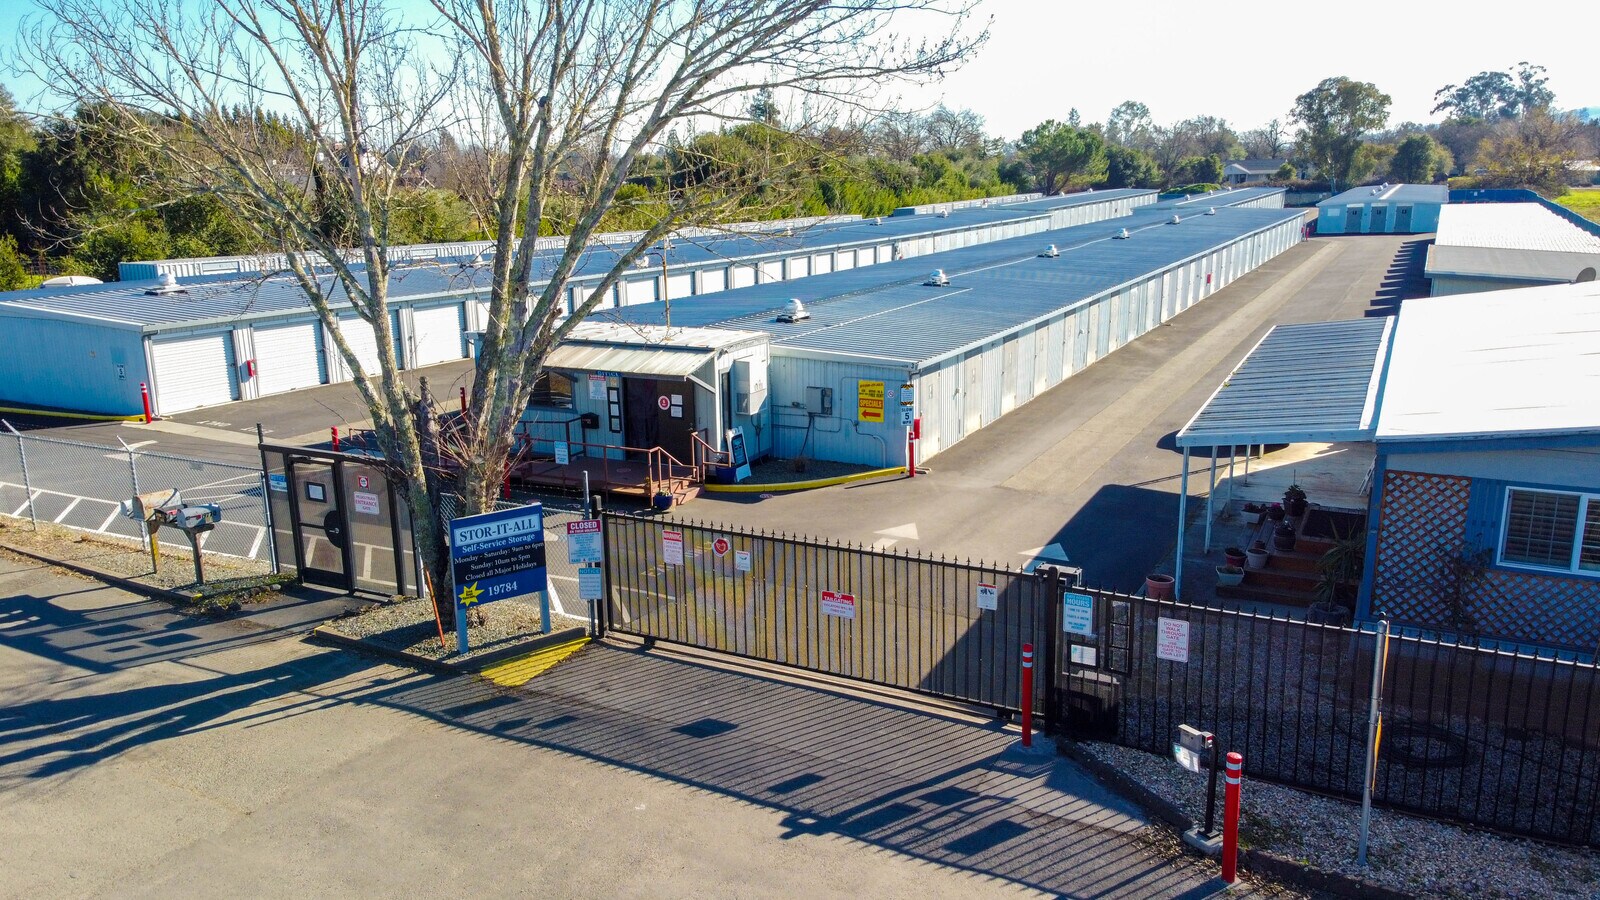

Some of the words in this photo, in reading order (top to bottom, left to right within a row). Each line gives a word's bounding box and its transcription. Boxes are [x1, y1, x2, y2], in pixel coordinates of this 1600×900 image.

[460, 519, 535, 542] STOR-IT-ALL
[570, 521, 597, 530] CLOSED
[462, 539, 506, 553] Self-Service
[508, 533, 535, 544] Storage
[454, 555, 478, 564] Monday
[484, 548, 510, 558] Saturday:
[465, 571, 485, 580] Closed
[495, 566, 511, 575] Major
[512, 561, 537, 571] Holidays
[470, 561, 493, 570] Sunday:
[488, 581, 518, 596] 19784
[824, 596, 852, 605] TAILGATING
[1067, 599, 1090, 607] HOURS
